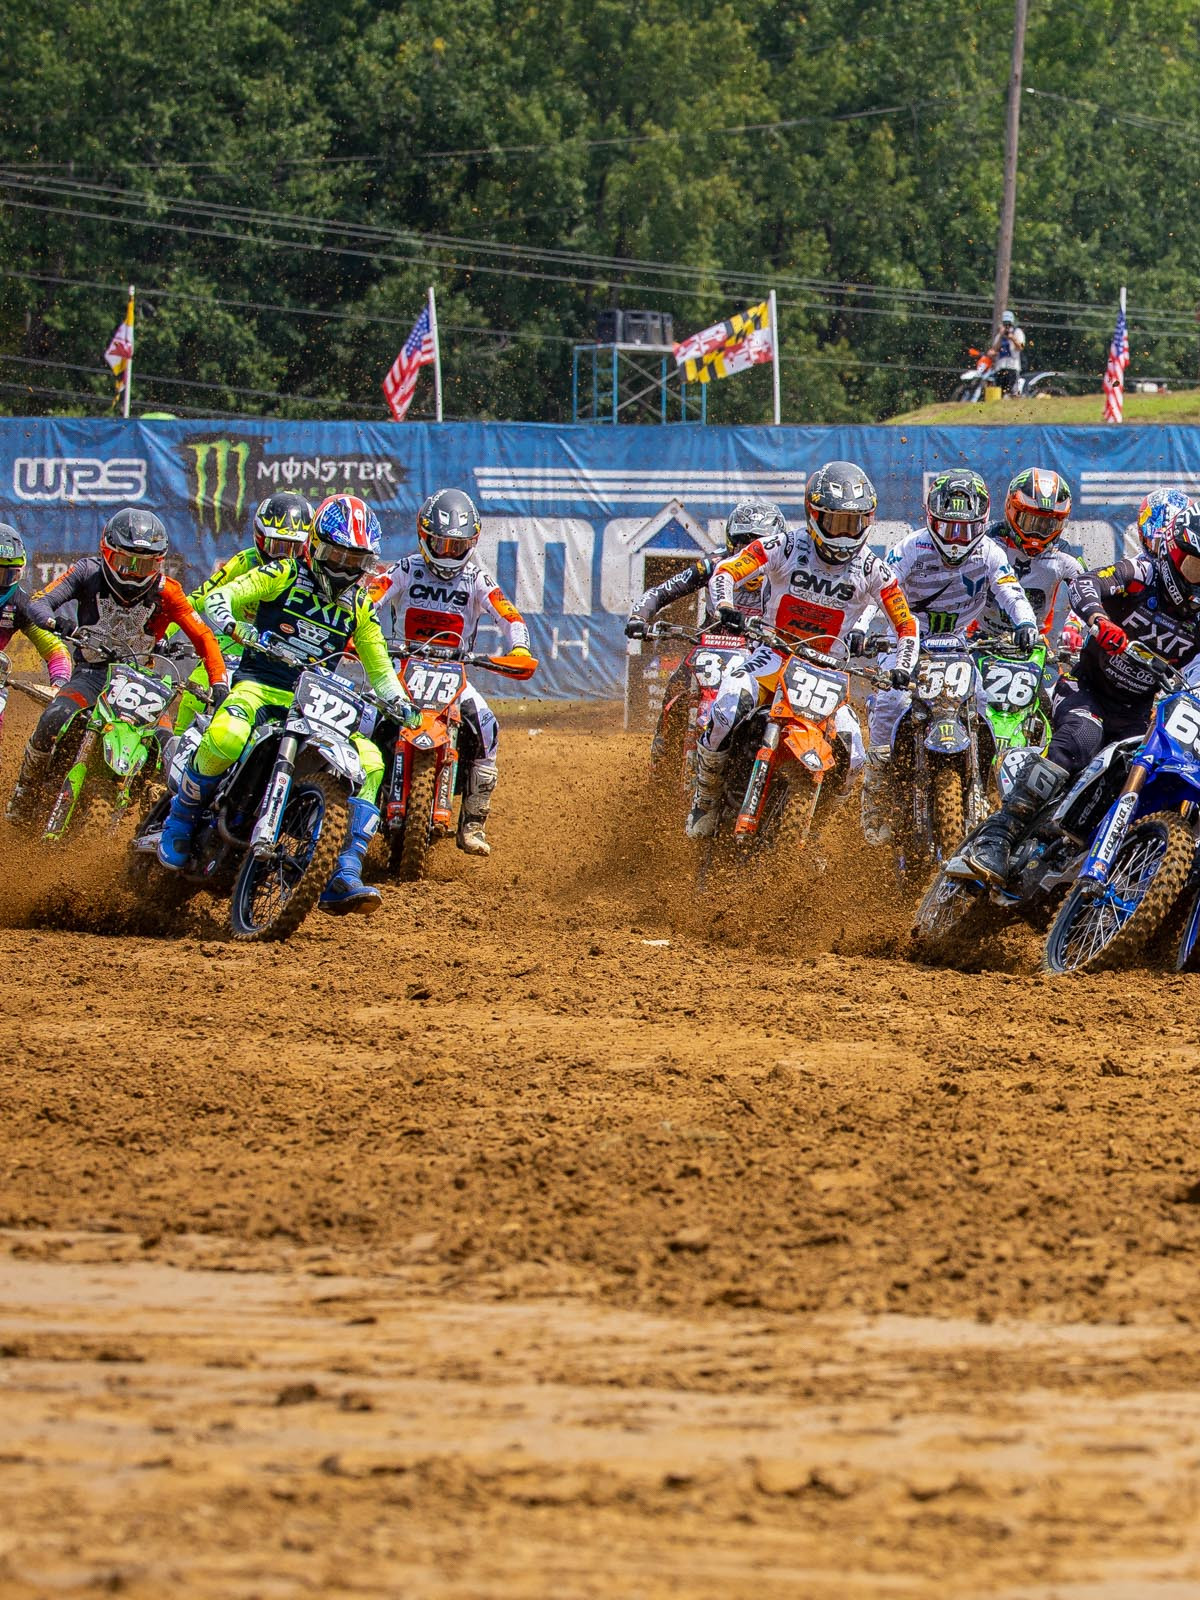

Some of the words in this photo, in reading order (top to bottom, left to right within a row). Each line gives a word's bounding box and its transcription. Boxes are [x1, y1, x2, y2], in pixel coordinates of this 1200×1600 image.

[13, 457, 147, 501] WPS
[257, 456, 396, 483] MONSTER
[409, 584, 470, 606] CNVS
[790, 570, 857, 601] CNVS
[1078, 579, 1098, 599] FXR
[284, 587, 355, 633] FXR
[926, 637, 958, 648] PROTAPER
[1122, 611, 1195, 657] FXR
[106, 674, 167, 722] 162
[408, 670, 461, 704] 473
[787, 671, 843, 717] 35
[918, 661, 972, 699] 59
[985, 666, 1038, 707] 26
[304, 687, 358, 738] 322
[1101, 808, 1128, 861] DUNLOP
